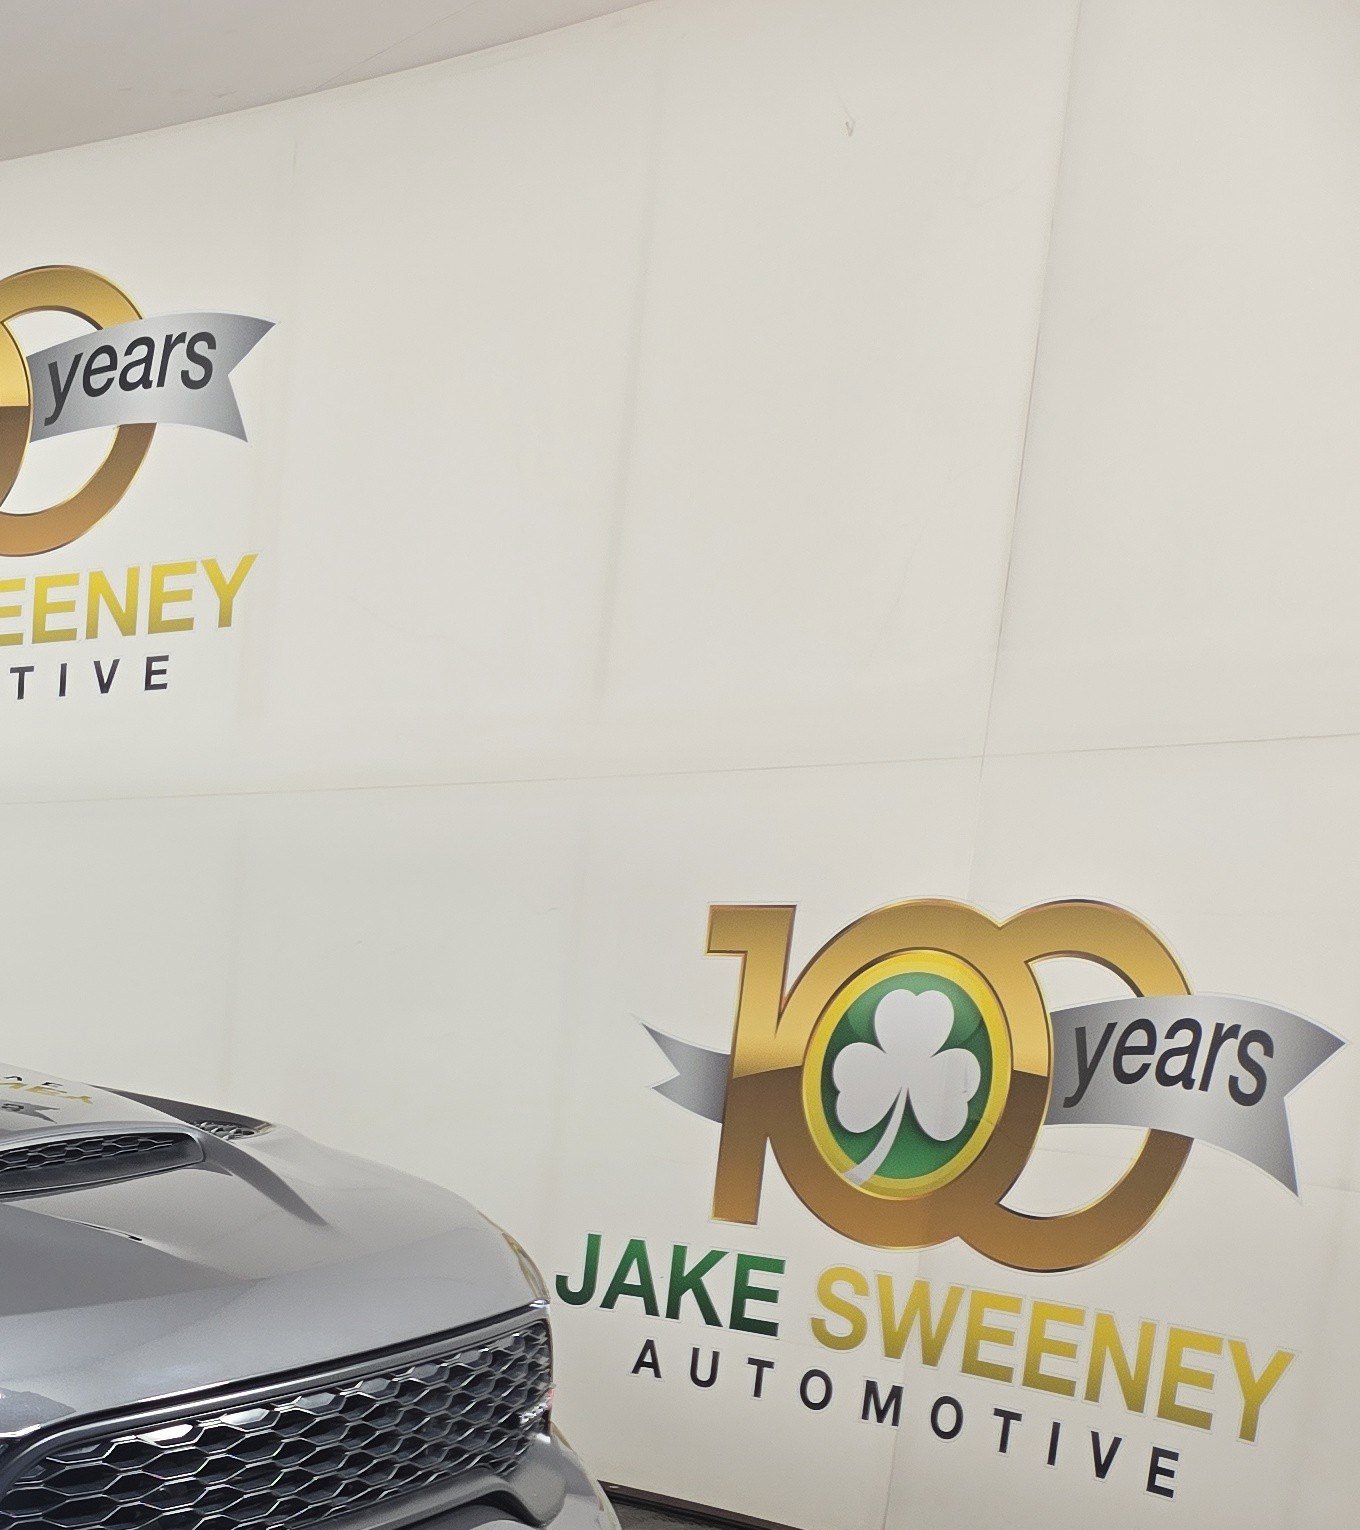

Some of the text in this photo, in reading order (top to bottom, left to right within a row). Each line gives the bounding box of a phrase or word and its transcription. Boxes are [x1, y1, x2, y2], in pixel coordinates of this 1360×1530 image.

[43, 330, 217, 427] years
[706, 898, 1194, 1274] 100
[1062, 1016, 1275, 1109] years
[555, 1233, 1295, 1443] JAKE SWEENEY
[632, 1338, 1180, 1499] AUTOMOTIVE
